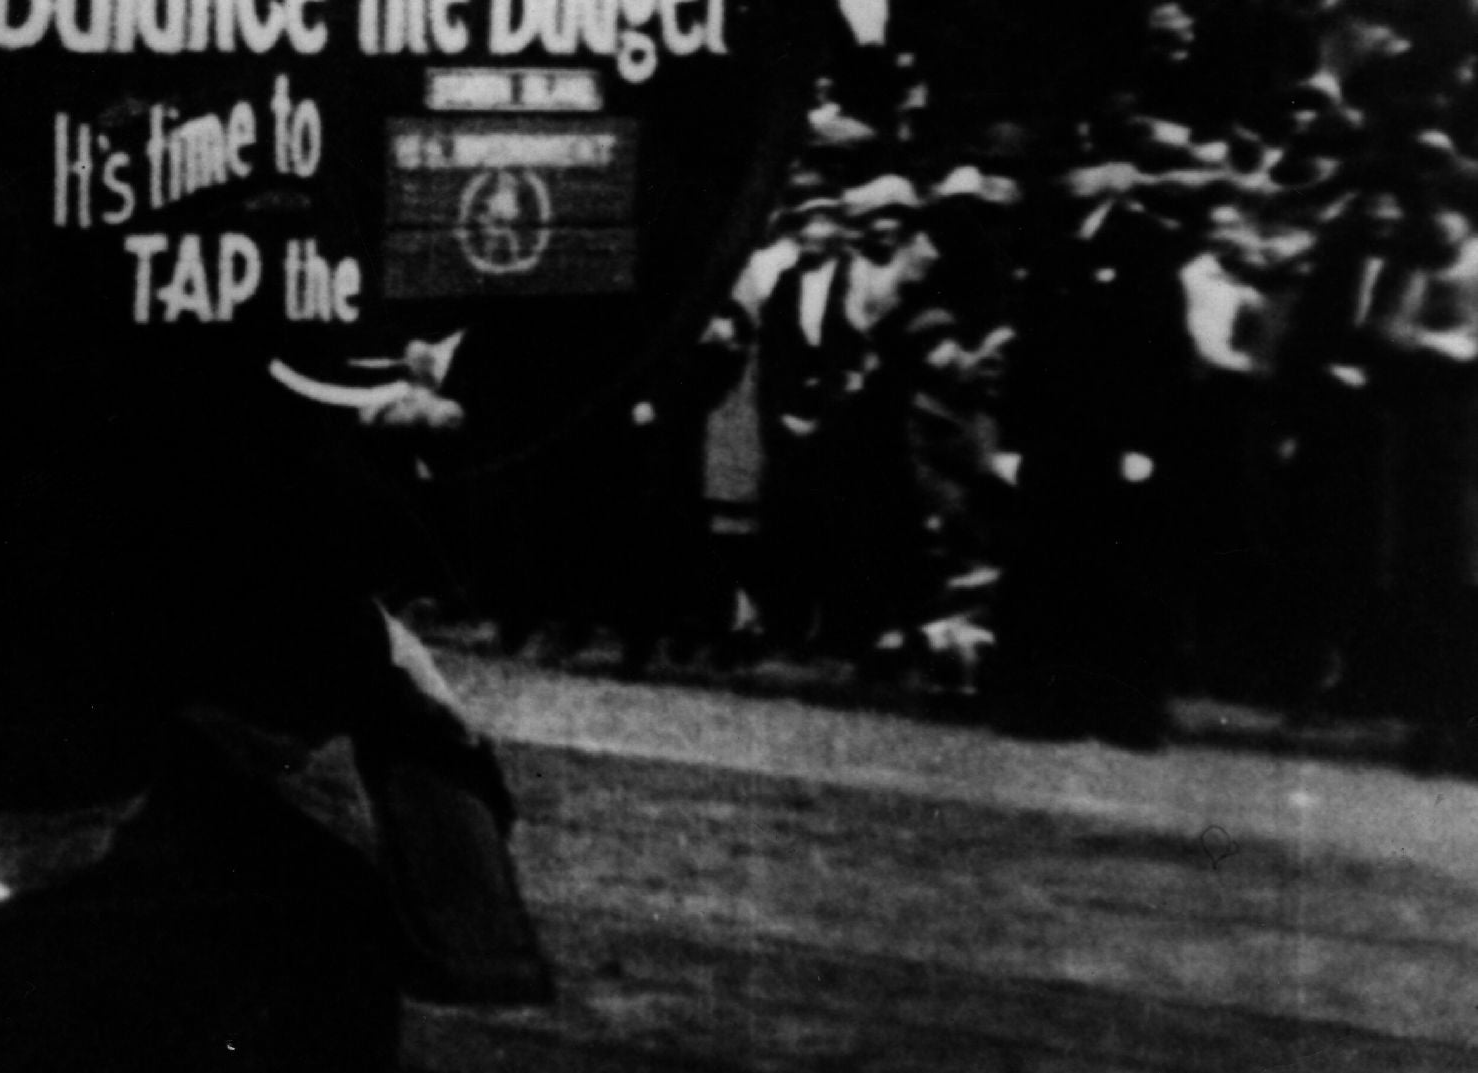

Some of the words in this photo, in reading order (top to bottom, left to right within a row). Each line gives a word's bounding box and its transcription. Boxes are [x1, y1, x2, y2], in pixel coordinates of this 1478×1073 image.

[51, 110, 137, 229] It's
[146, 102, 254, 210] time
[270, 72, 323, 179] to
[123, 231, 262, 325] TAP
[282, 238, 362, 322] the
